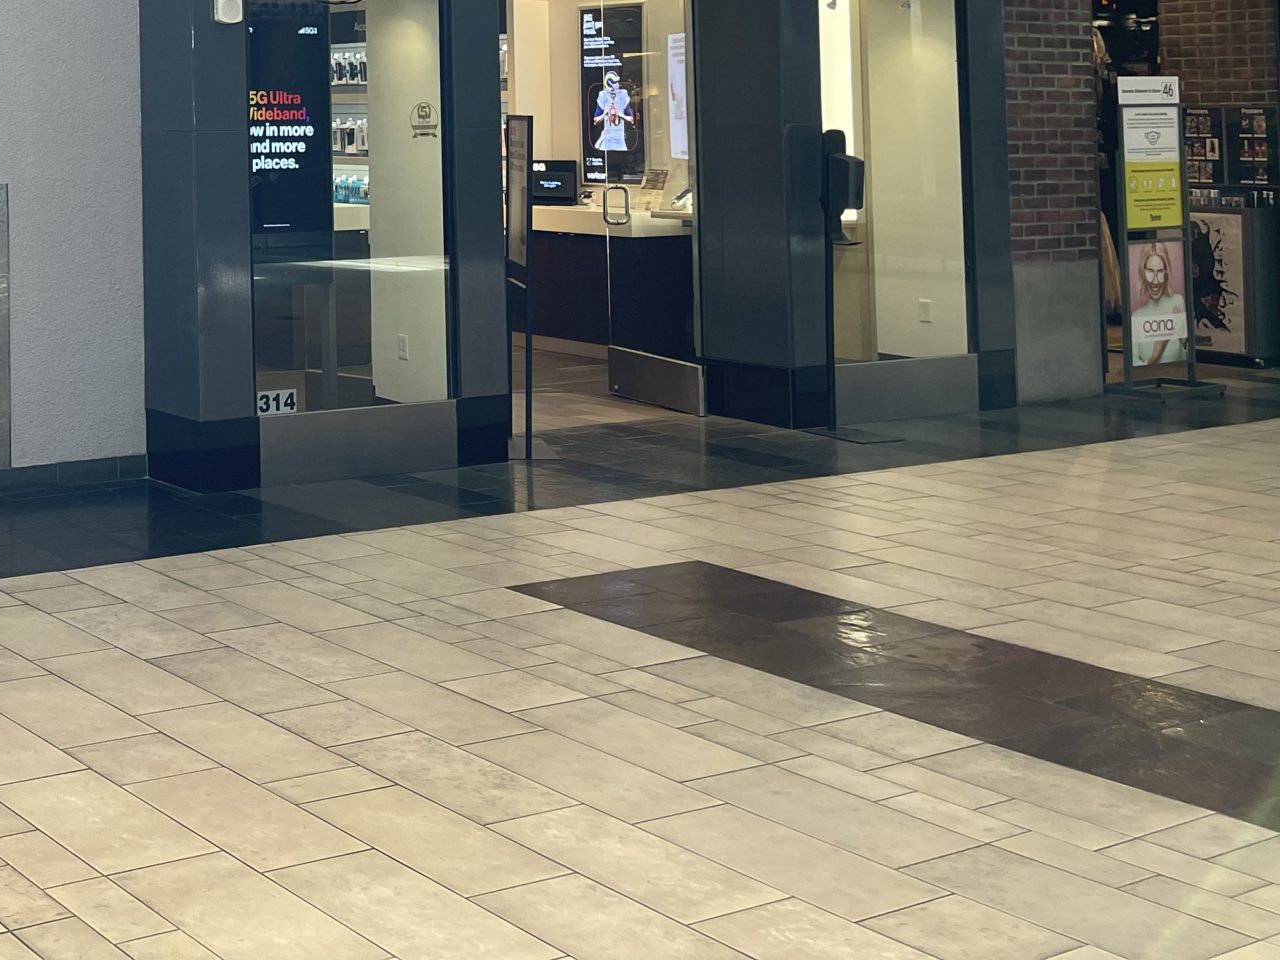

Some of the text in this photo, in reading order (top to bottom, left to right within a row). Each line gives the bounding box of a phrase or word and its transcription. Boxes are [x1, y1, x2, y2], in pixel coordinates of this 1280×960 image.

[1162, 83, 1174, 97] 46
[249, 91, 302, 105] 5G Ultra
[265, 122, 278, 137] in
[279, 125, 315, 137] more
[250, 138, 306, 153] nd more
[252, 155, 300, 173] places.
[258, 391, 296, 413] 314
